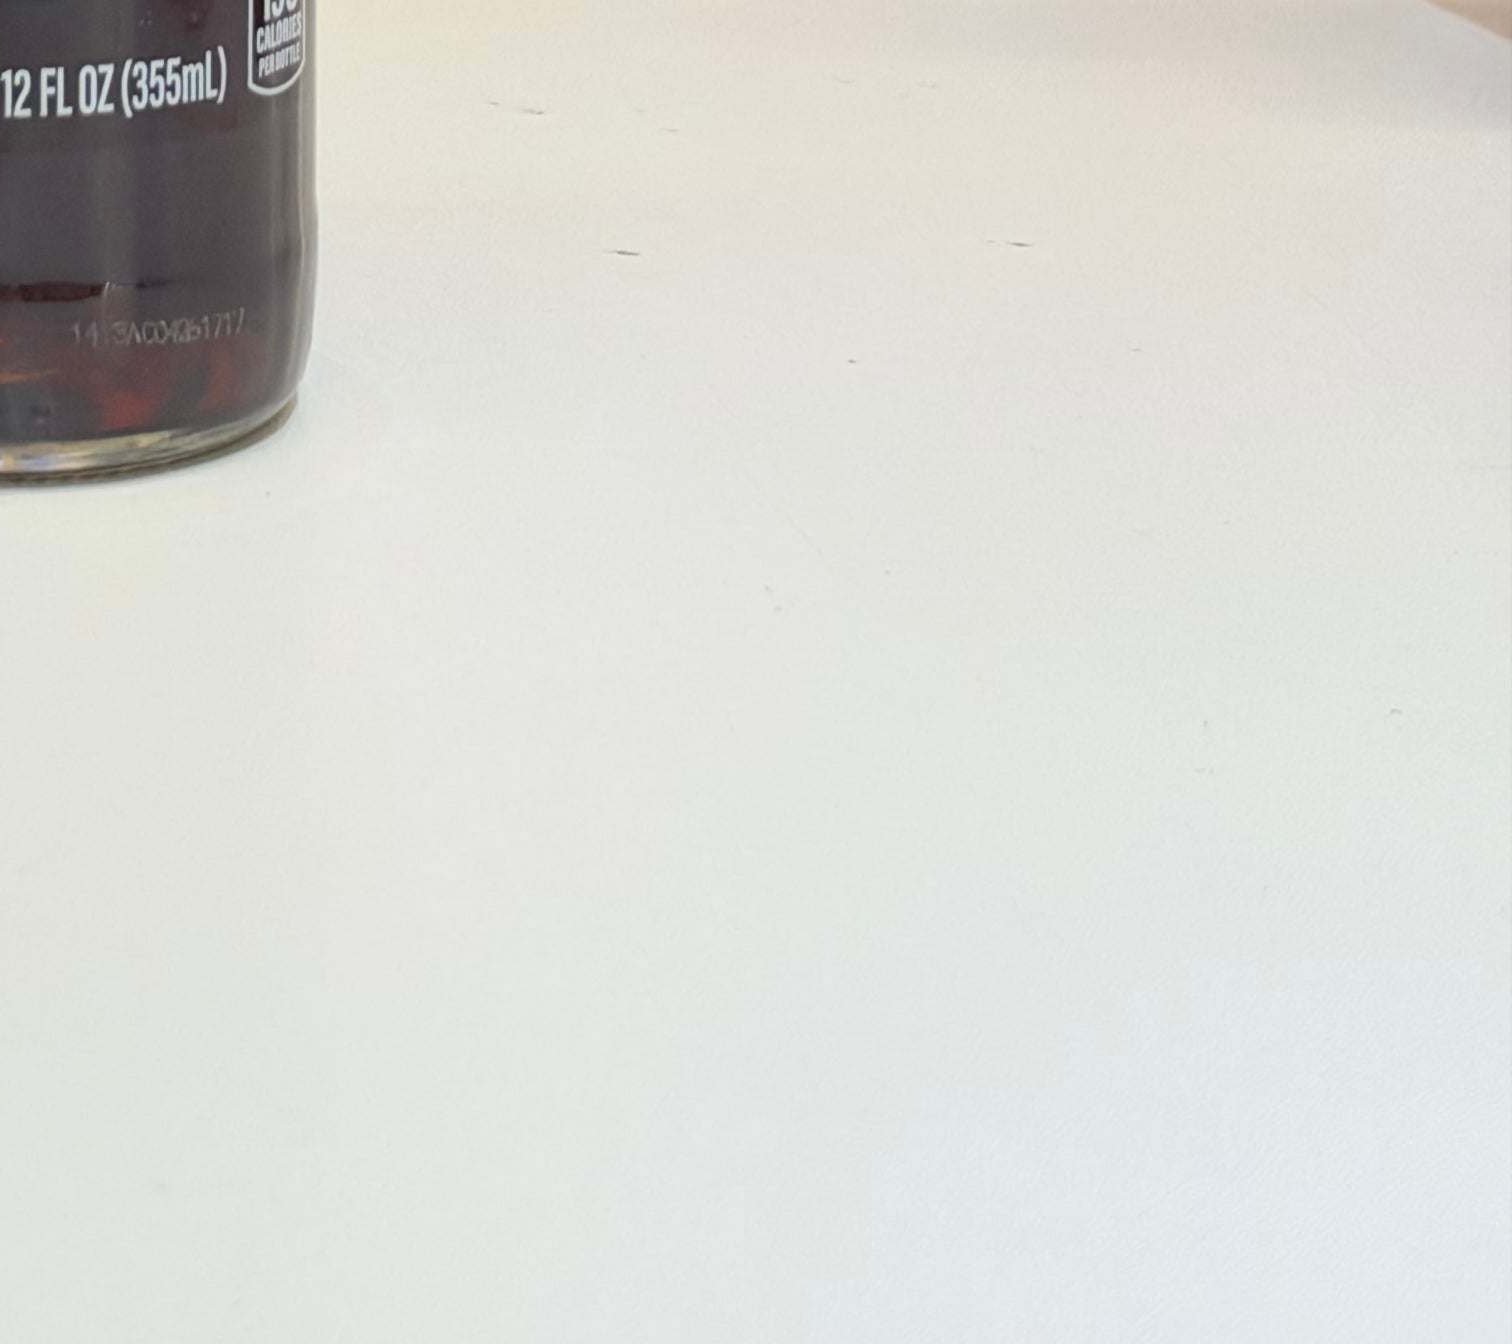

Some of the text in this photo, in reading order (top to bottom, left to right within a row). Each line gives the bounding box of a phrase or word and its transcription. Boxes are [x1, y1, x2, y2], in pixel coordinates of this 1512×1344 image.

[256, 10, 302, 54] CALORIES
[0, 45, 227, 119] 12 FL OZ (355mL)
[258, 41, 301, 79] PER BOTTLE
